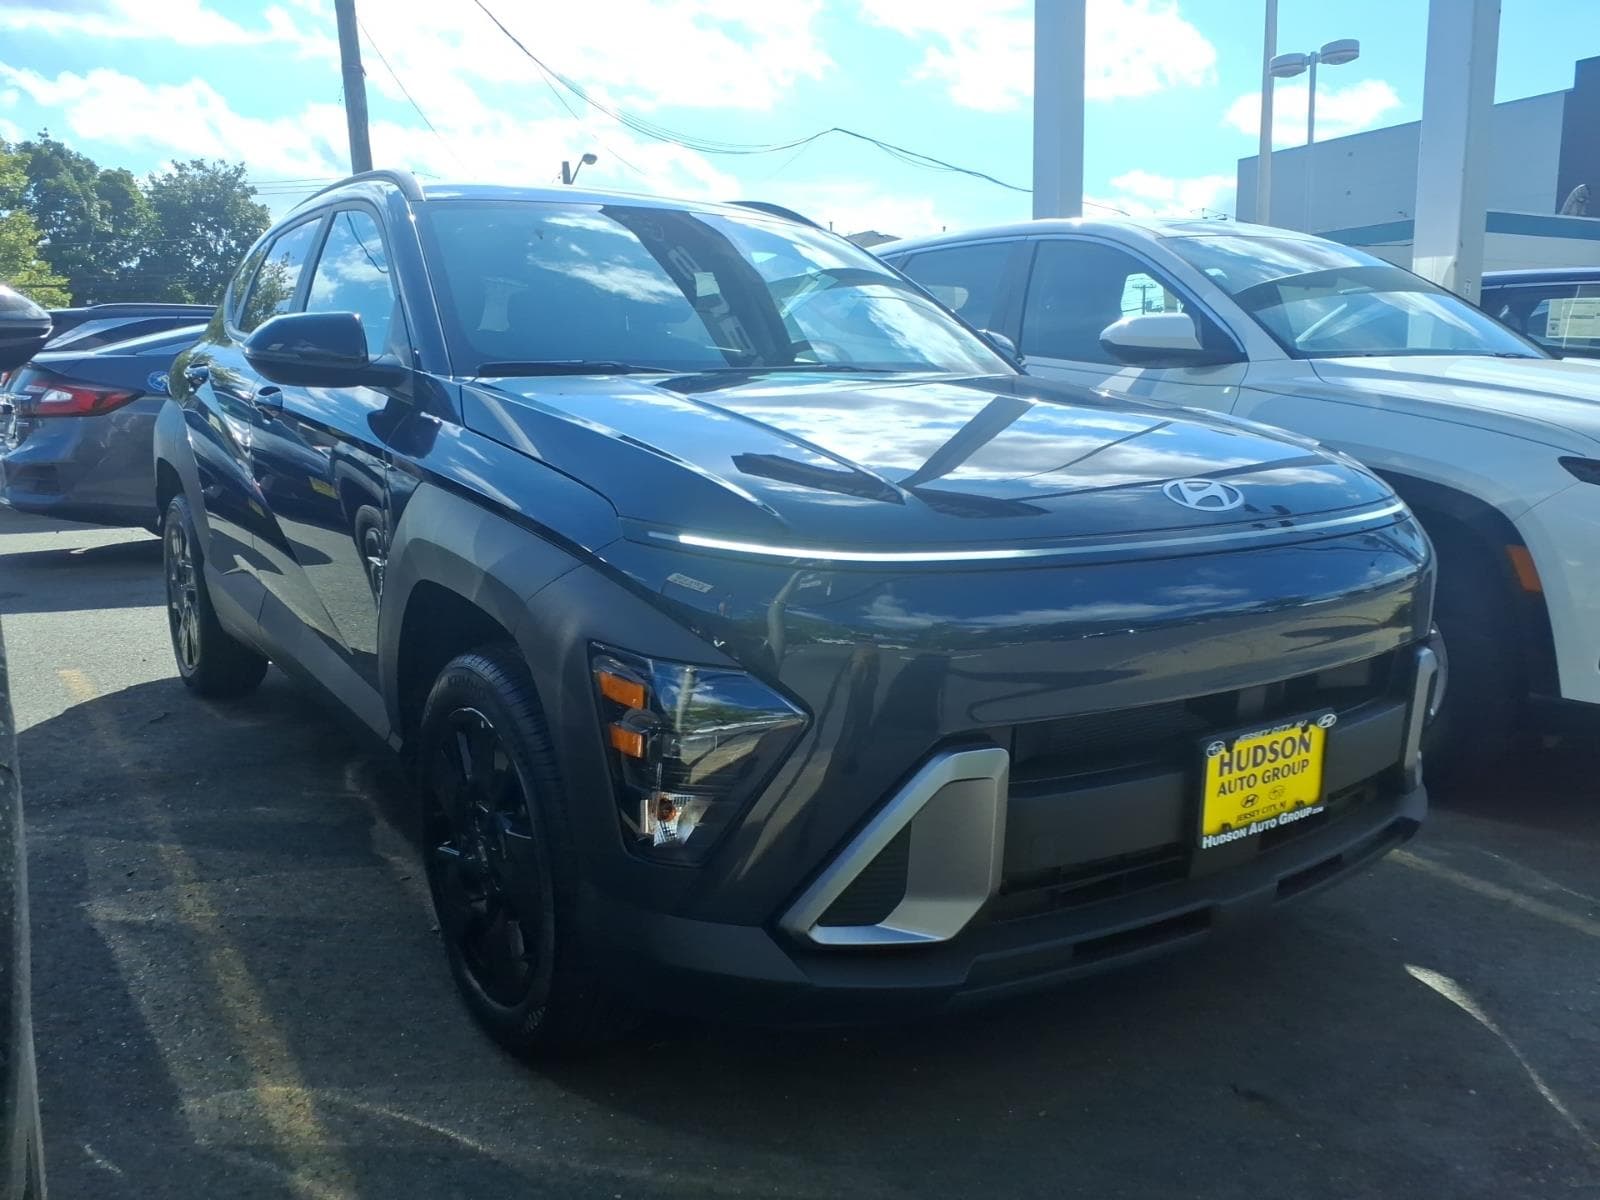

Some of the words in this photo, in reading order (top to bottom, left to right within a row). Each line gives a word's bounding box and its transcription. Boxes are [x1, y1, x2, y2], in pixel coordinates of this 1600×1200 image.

[1219, 732, 1312, 777] HUDSON
[1216, 773, 1258, 797] AUTO
[1261, 758, 1310, 784] GROUP
[1202, 828, 1247, 849] HUDSON
[1249, 818, 1277, 835] AUTO
